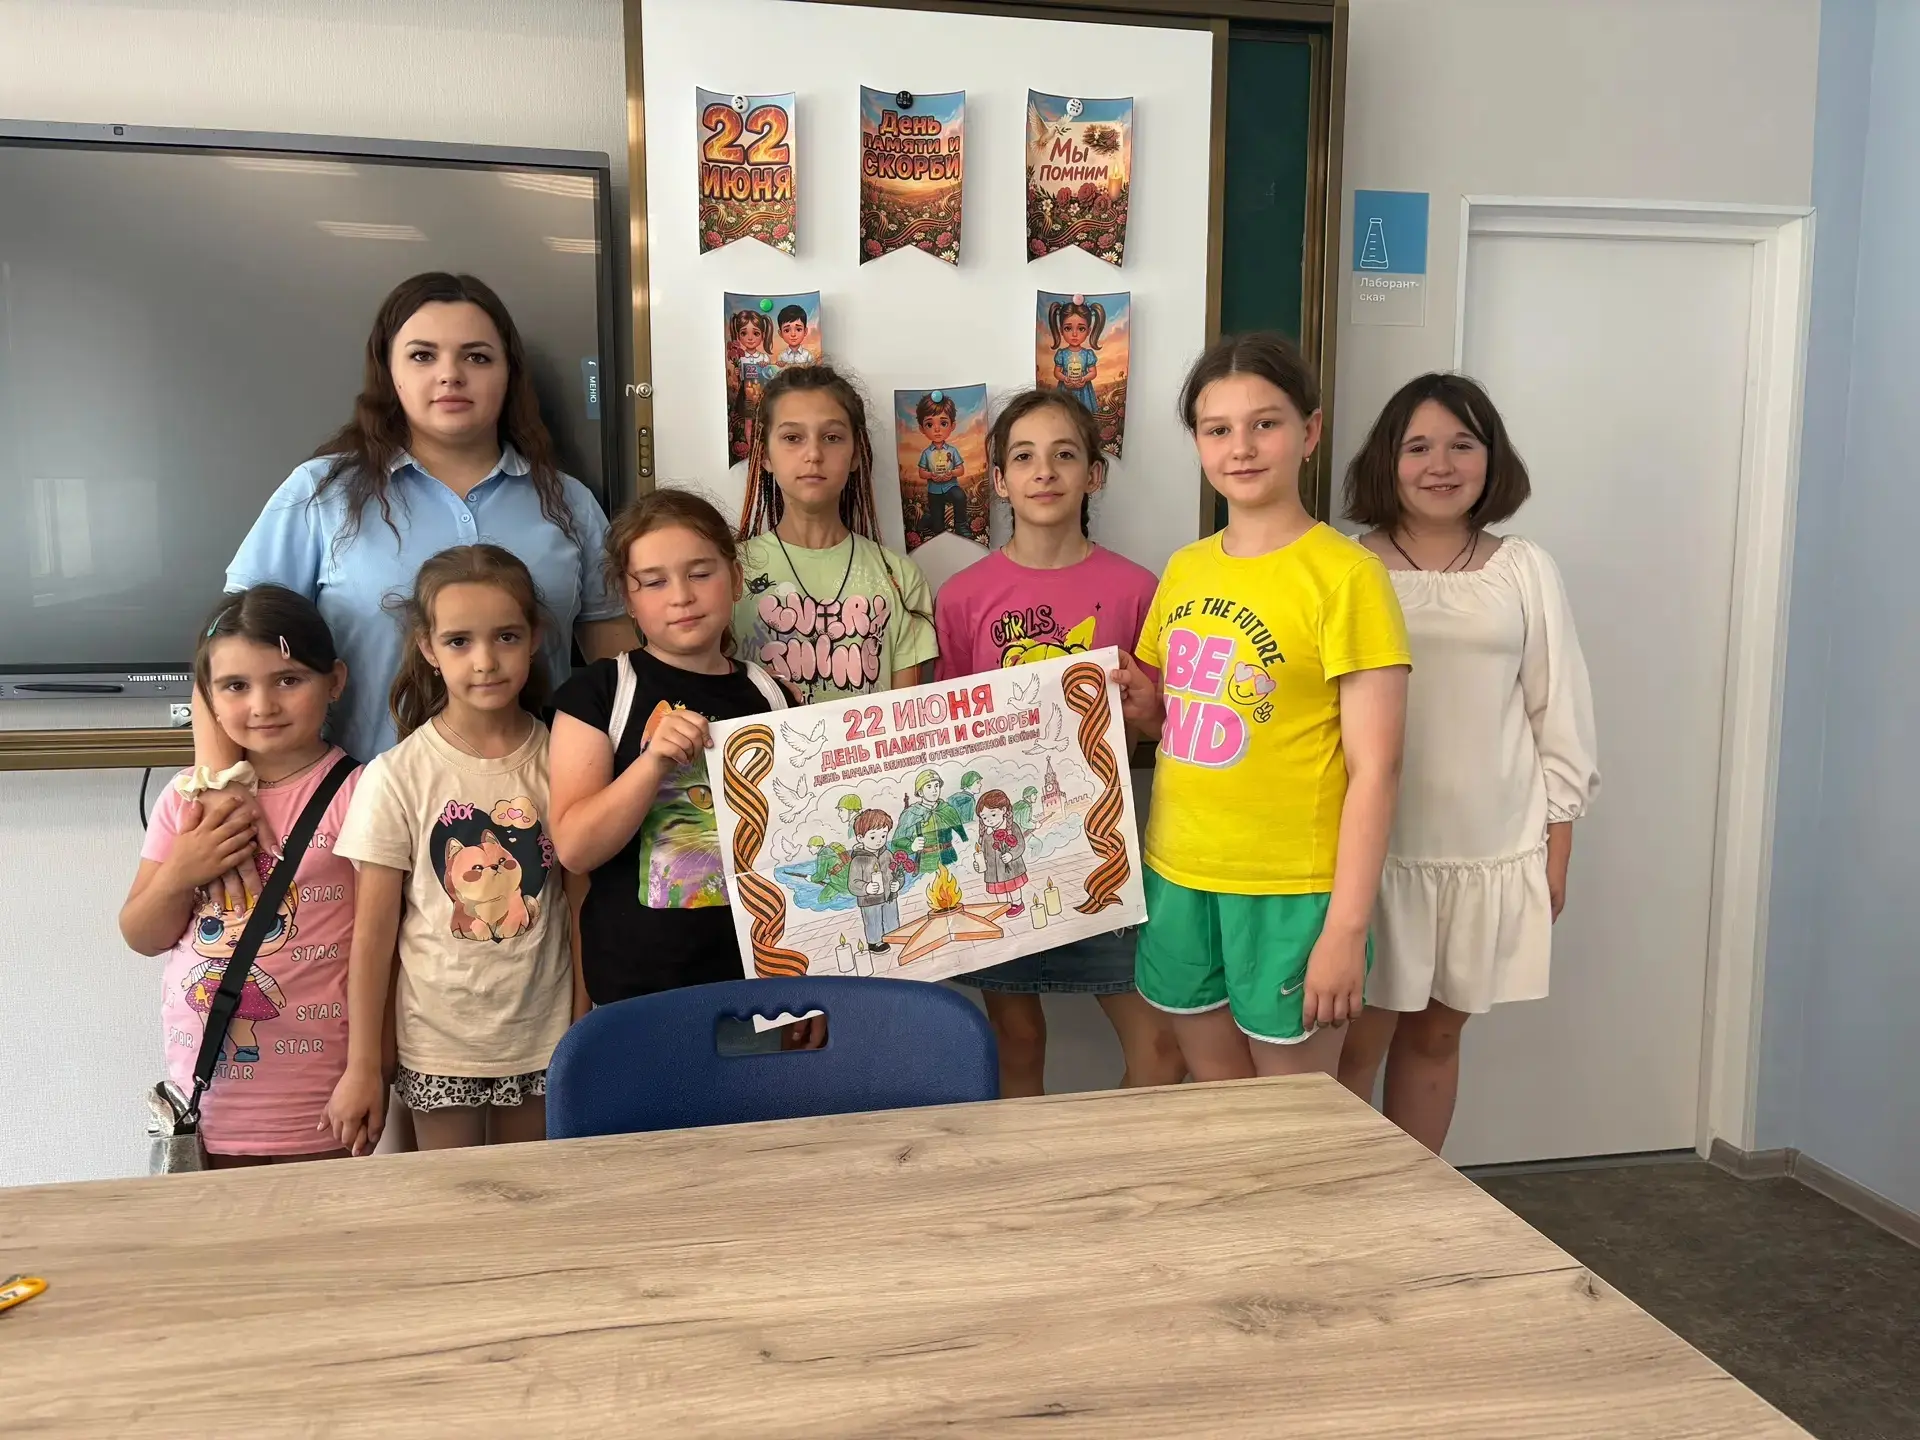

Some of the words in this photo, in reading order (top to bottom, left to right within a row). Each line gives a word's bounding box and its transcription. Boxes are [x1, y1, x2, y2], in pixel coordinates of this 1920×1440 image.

[702, 103, 790, 166] 22
[878, 109, 942, 137] День
[863, 150, 960, 180] СКОРБИ
[1049, 137, 1089, 165] Мы
[702, 163, 792, 202] ИЮНЯ
[1360, 278, 1419, 289] Лаборант-
[1360, 292, 1386, 302] ская
[589, 376, 597, 403] МЕНЮ
[1166, 600, 1195, 628] ARE
[1201, 597, 1236, 619] THE
[1232, 607, 1285, 668] FUTURE
[1165, 627, 1235, 697] BE
[843, 705, 886, 742] 22
[892, 683, 995, 731] ИЮНЯ
[821, 745, 870, 772] ДЕНЬ
[875, 728, 950, 758] ПАМЯТИ
[954, 724, 968, 742] И
[972, 708, 1040, 739] СКОРБИ
[814, 771, 840, 787] ДЕНЬ
[842, 763, 882, 780] НАЧАЛА
[883, 752, 928, 771] ВЕЛИКОЙ
[1007, 728, 1040, 745] ВОЙНЫ
[300, 885, 345, 902] STAR
[291, 943, 339, 962] STAR
[296, 1003, 342, 1022] STAR
[275, 1039, 324, 1055] STAR
